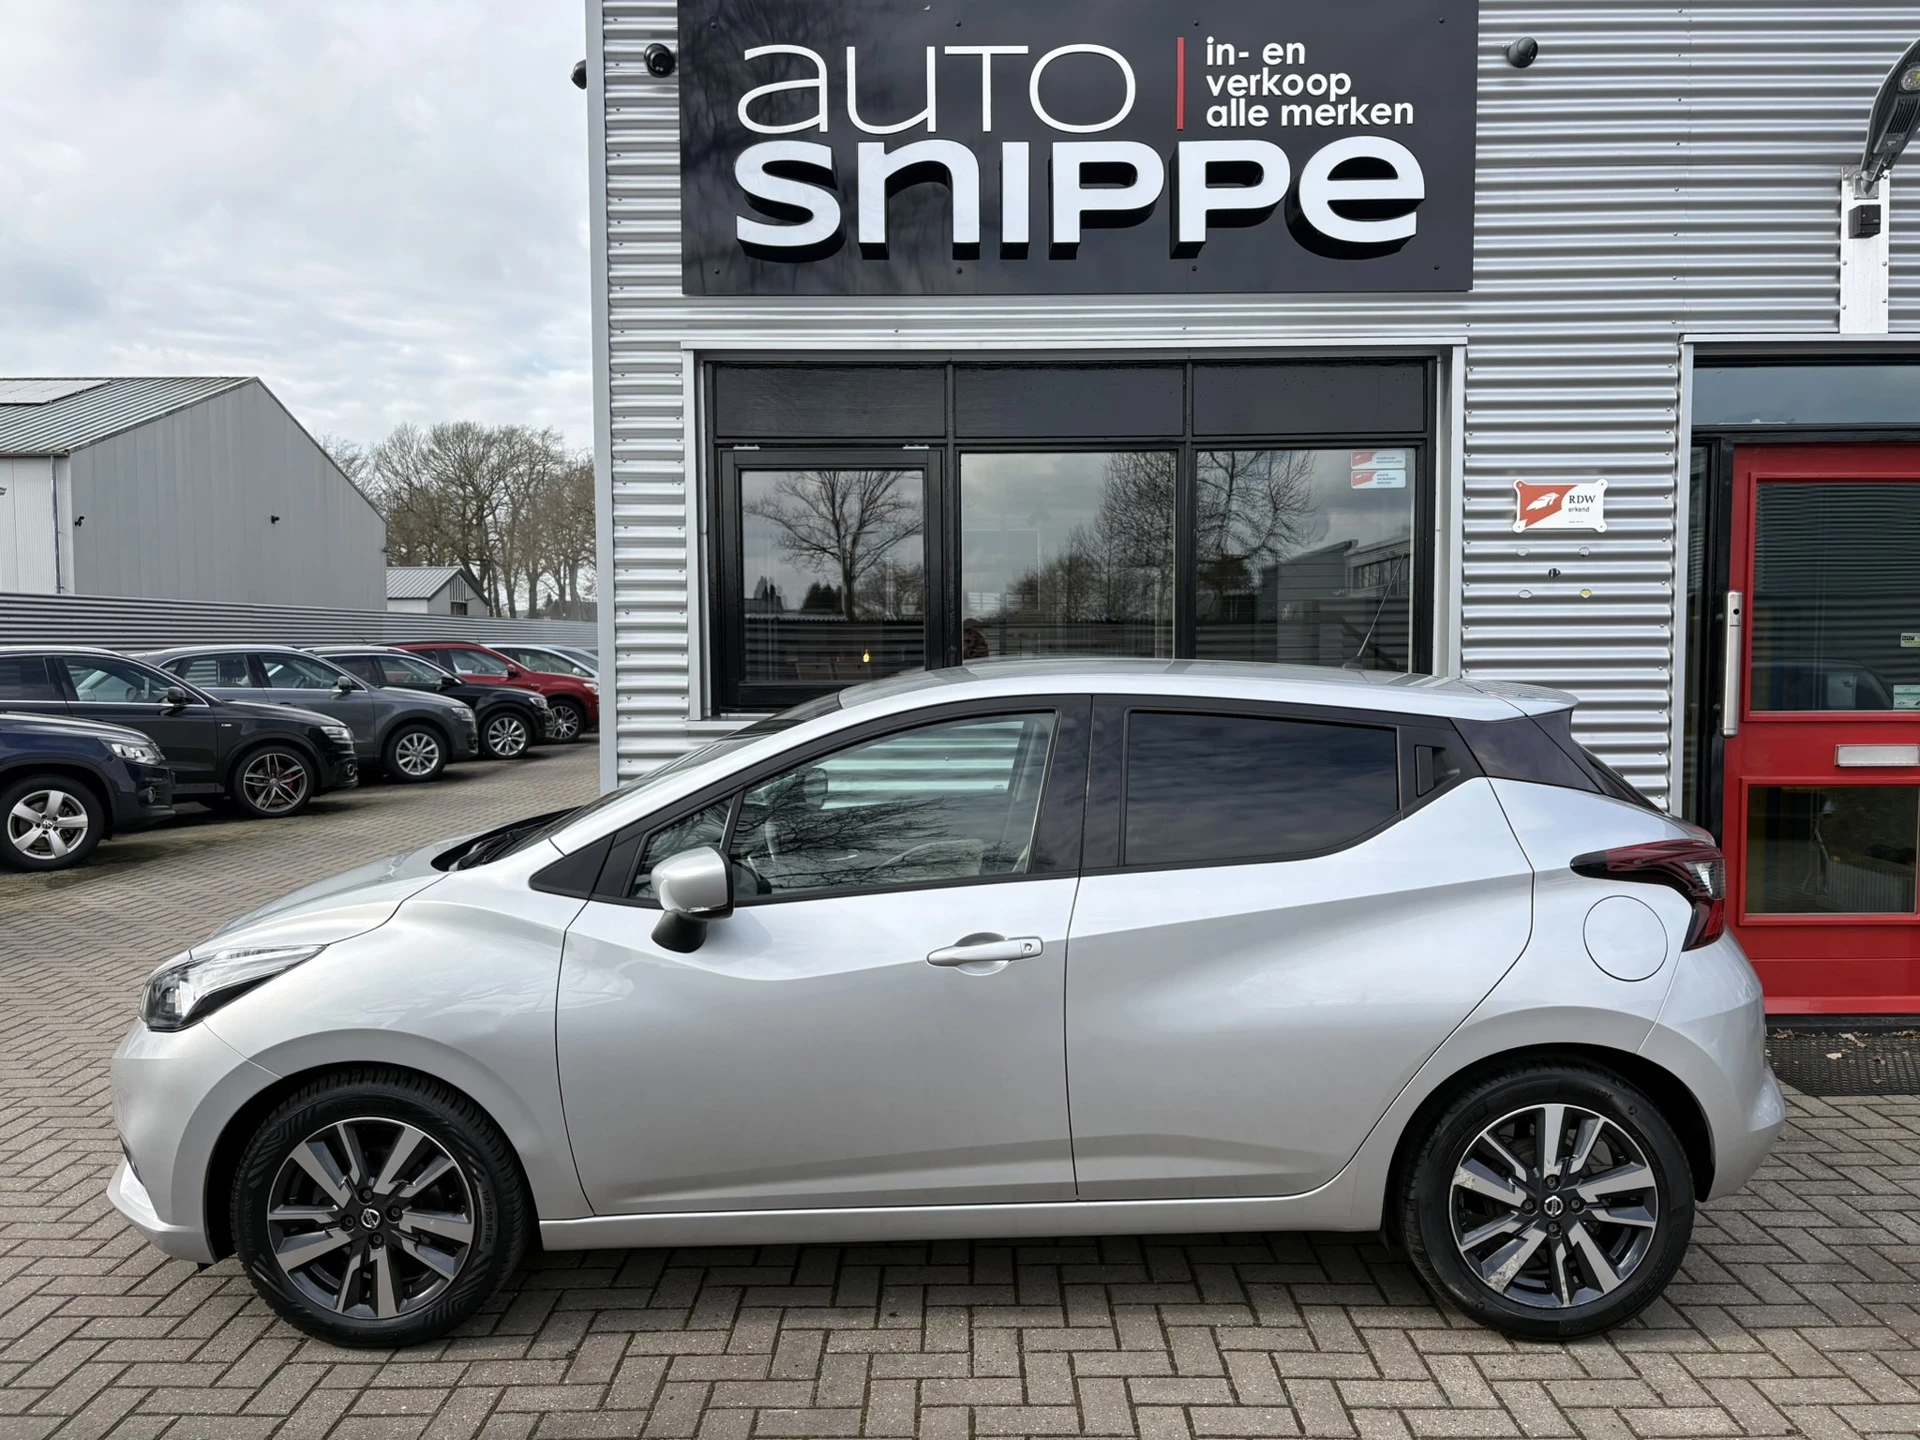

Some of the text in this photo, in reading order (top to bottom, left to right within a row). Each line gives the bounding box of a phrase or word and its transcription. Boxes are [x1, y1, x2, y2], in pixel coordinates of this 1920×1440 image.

[1206, 36, 1306, 66] in- en
[1205, 67, 1352, 102] verkoop
[1206, 97, 1414, 127] alle merken
[1568, 494, 1597, 504] RDW
